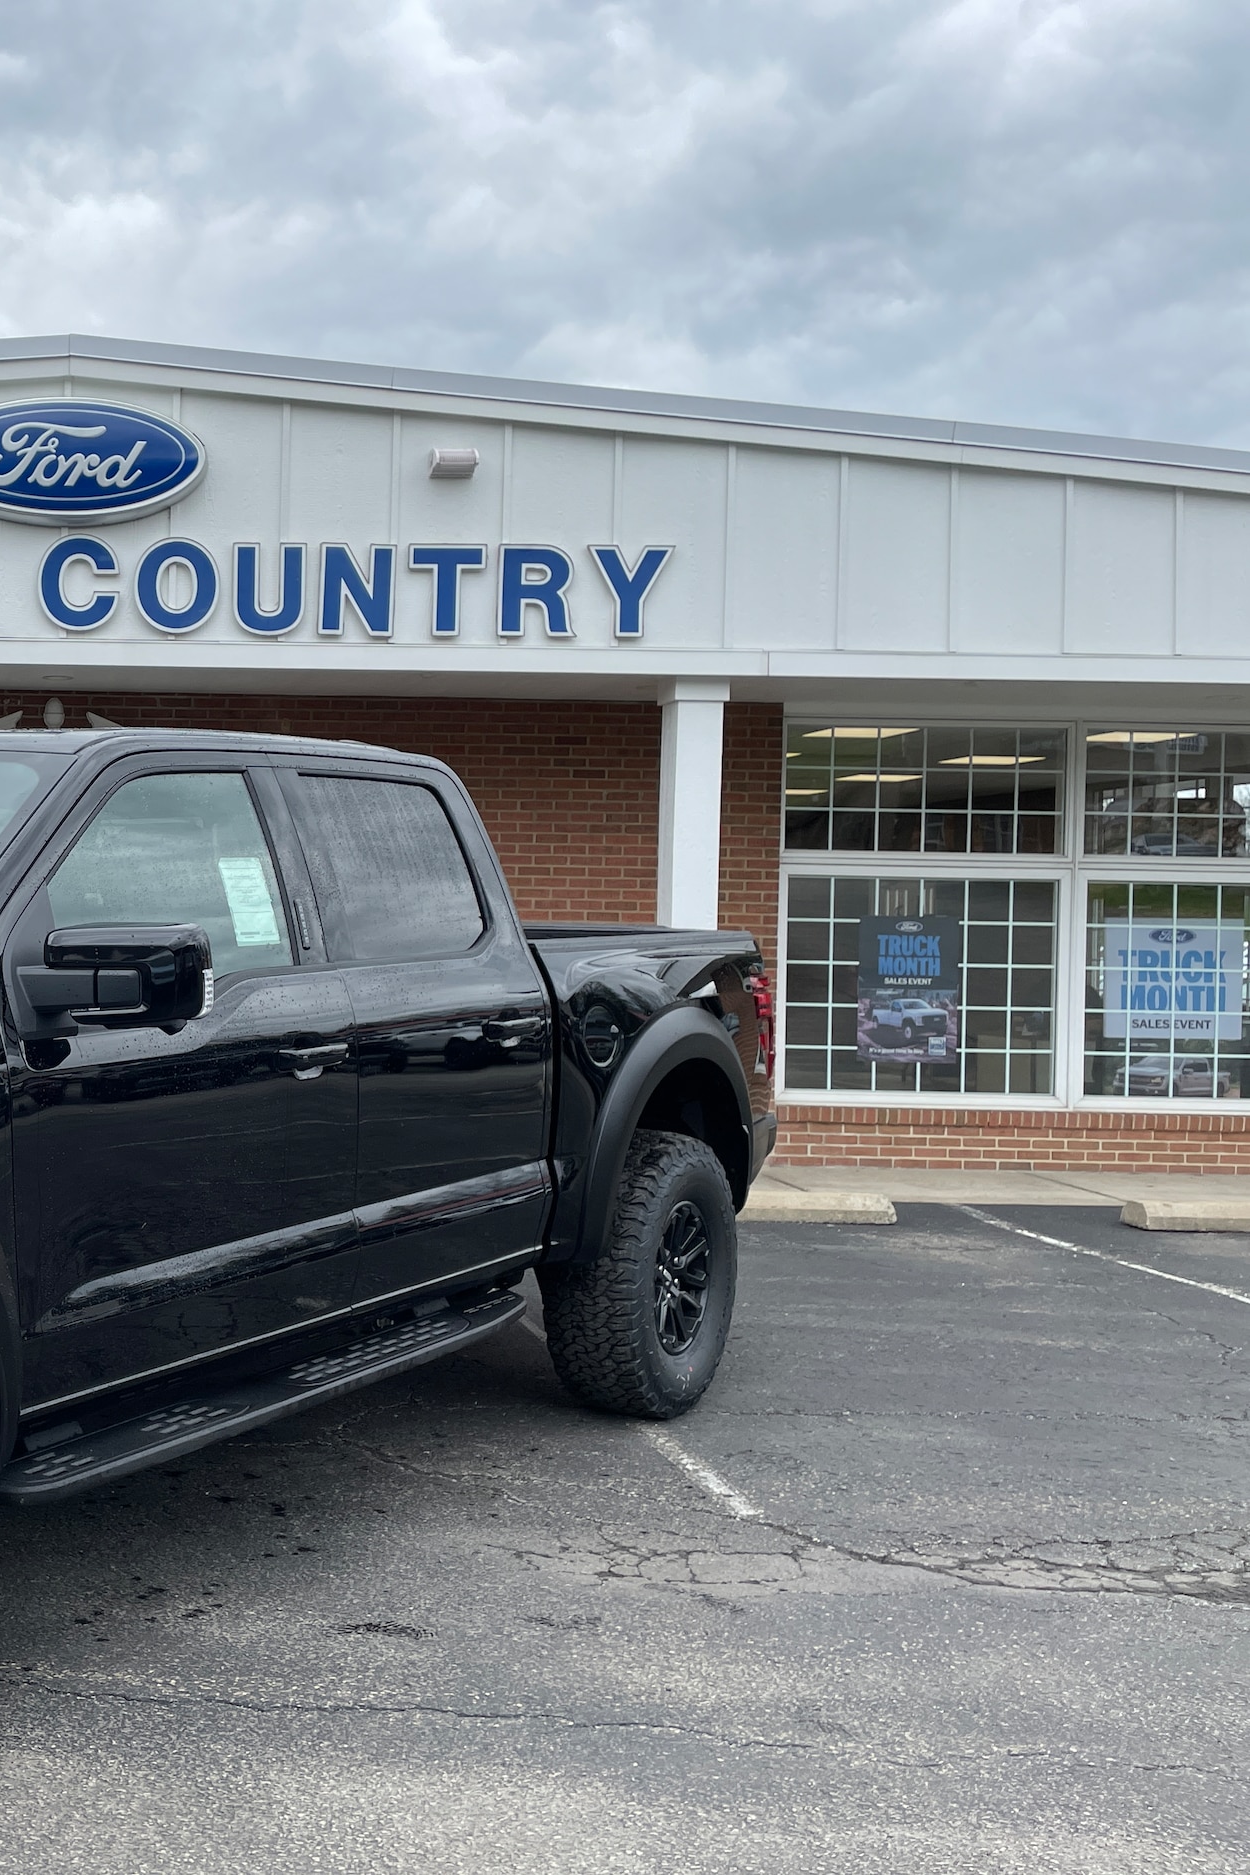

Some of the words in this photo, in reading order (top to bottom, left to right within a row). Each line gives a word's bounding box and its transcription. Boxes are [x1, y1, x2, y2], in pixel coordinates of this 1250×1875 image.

[37, 534, 676, 639] COUNTRY
[877, 934, 941, 957] TRUCK
[877, 956, 941, 977] MONTH
[1118, 949, 1227, 984] TRUCK
[884, 977, 908, 985] SALES
[908, 978, 933, 986] EVENT
[1120, 984, 1227, 1013] MONTH
[1132, 1018, 1170, 1030] SALES
[1174, 1019, 1212, 1030] EVENT
